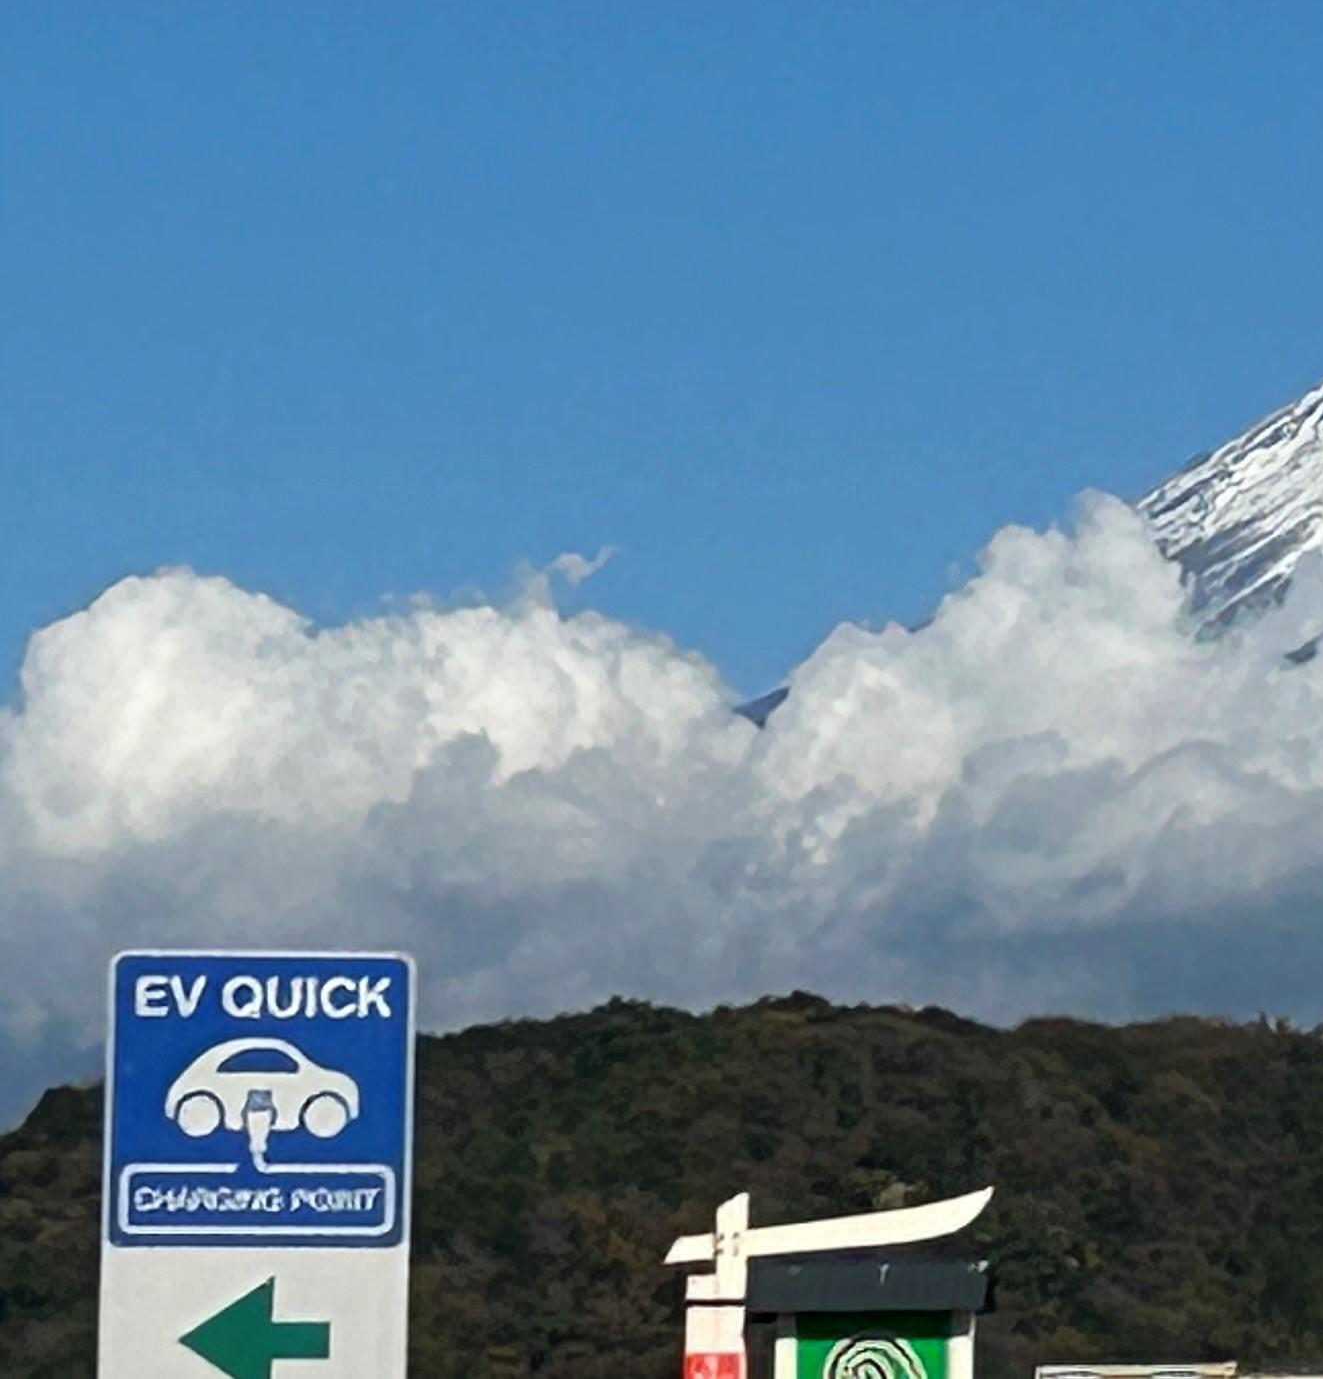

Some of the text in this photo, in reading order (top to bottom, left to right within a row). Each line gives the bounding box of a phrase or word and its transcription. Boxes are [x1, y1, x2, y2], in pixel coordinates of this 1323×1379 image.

[135, 975, 392, 1019] EV QUICK
[290, 1187, 382, 1212] POINT
